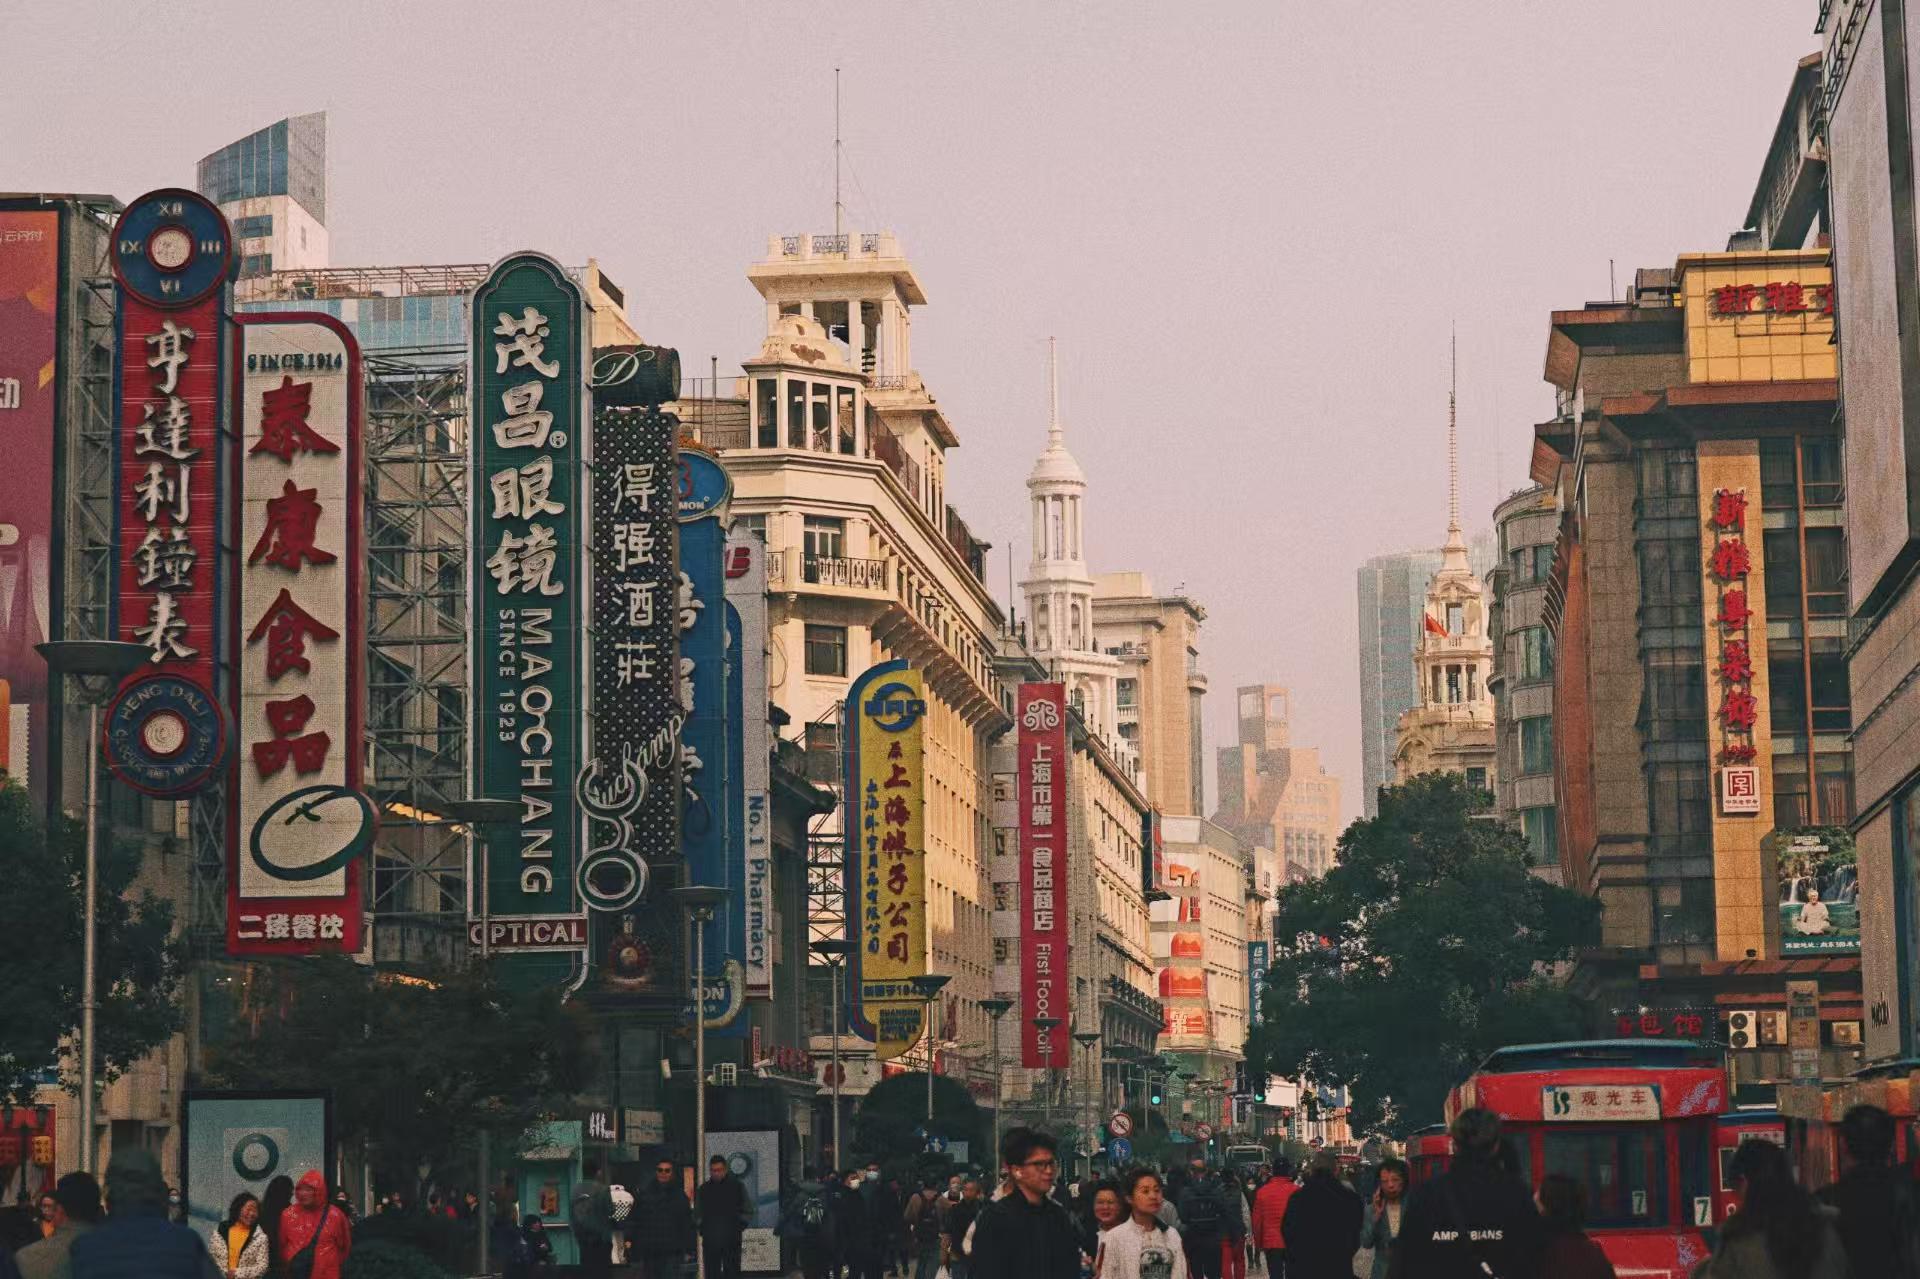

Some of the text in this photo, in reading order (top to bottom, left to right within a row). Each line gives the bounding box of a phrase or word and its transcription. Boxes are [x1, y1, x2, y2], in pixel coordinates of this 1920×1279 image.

[201, 240, 220, 254] III
[247, 375, 341, 778] 泰康食品
[499, 608, 516, 742] SINCE 1923
[520, 607, 553, 893] MAOCHANG
[1031, 742, 1054, 931] 上海市第一食品商店
[470, 922, 585, 944] OPTICAL
[748, 858, 766, 969] Pharmacy
[1036, 943, 1051, 976] First
[1581, 1090, 1648, 1106] 观光车
